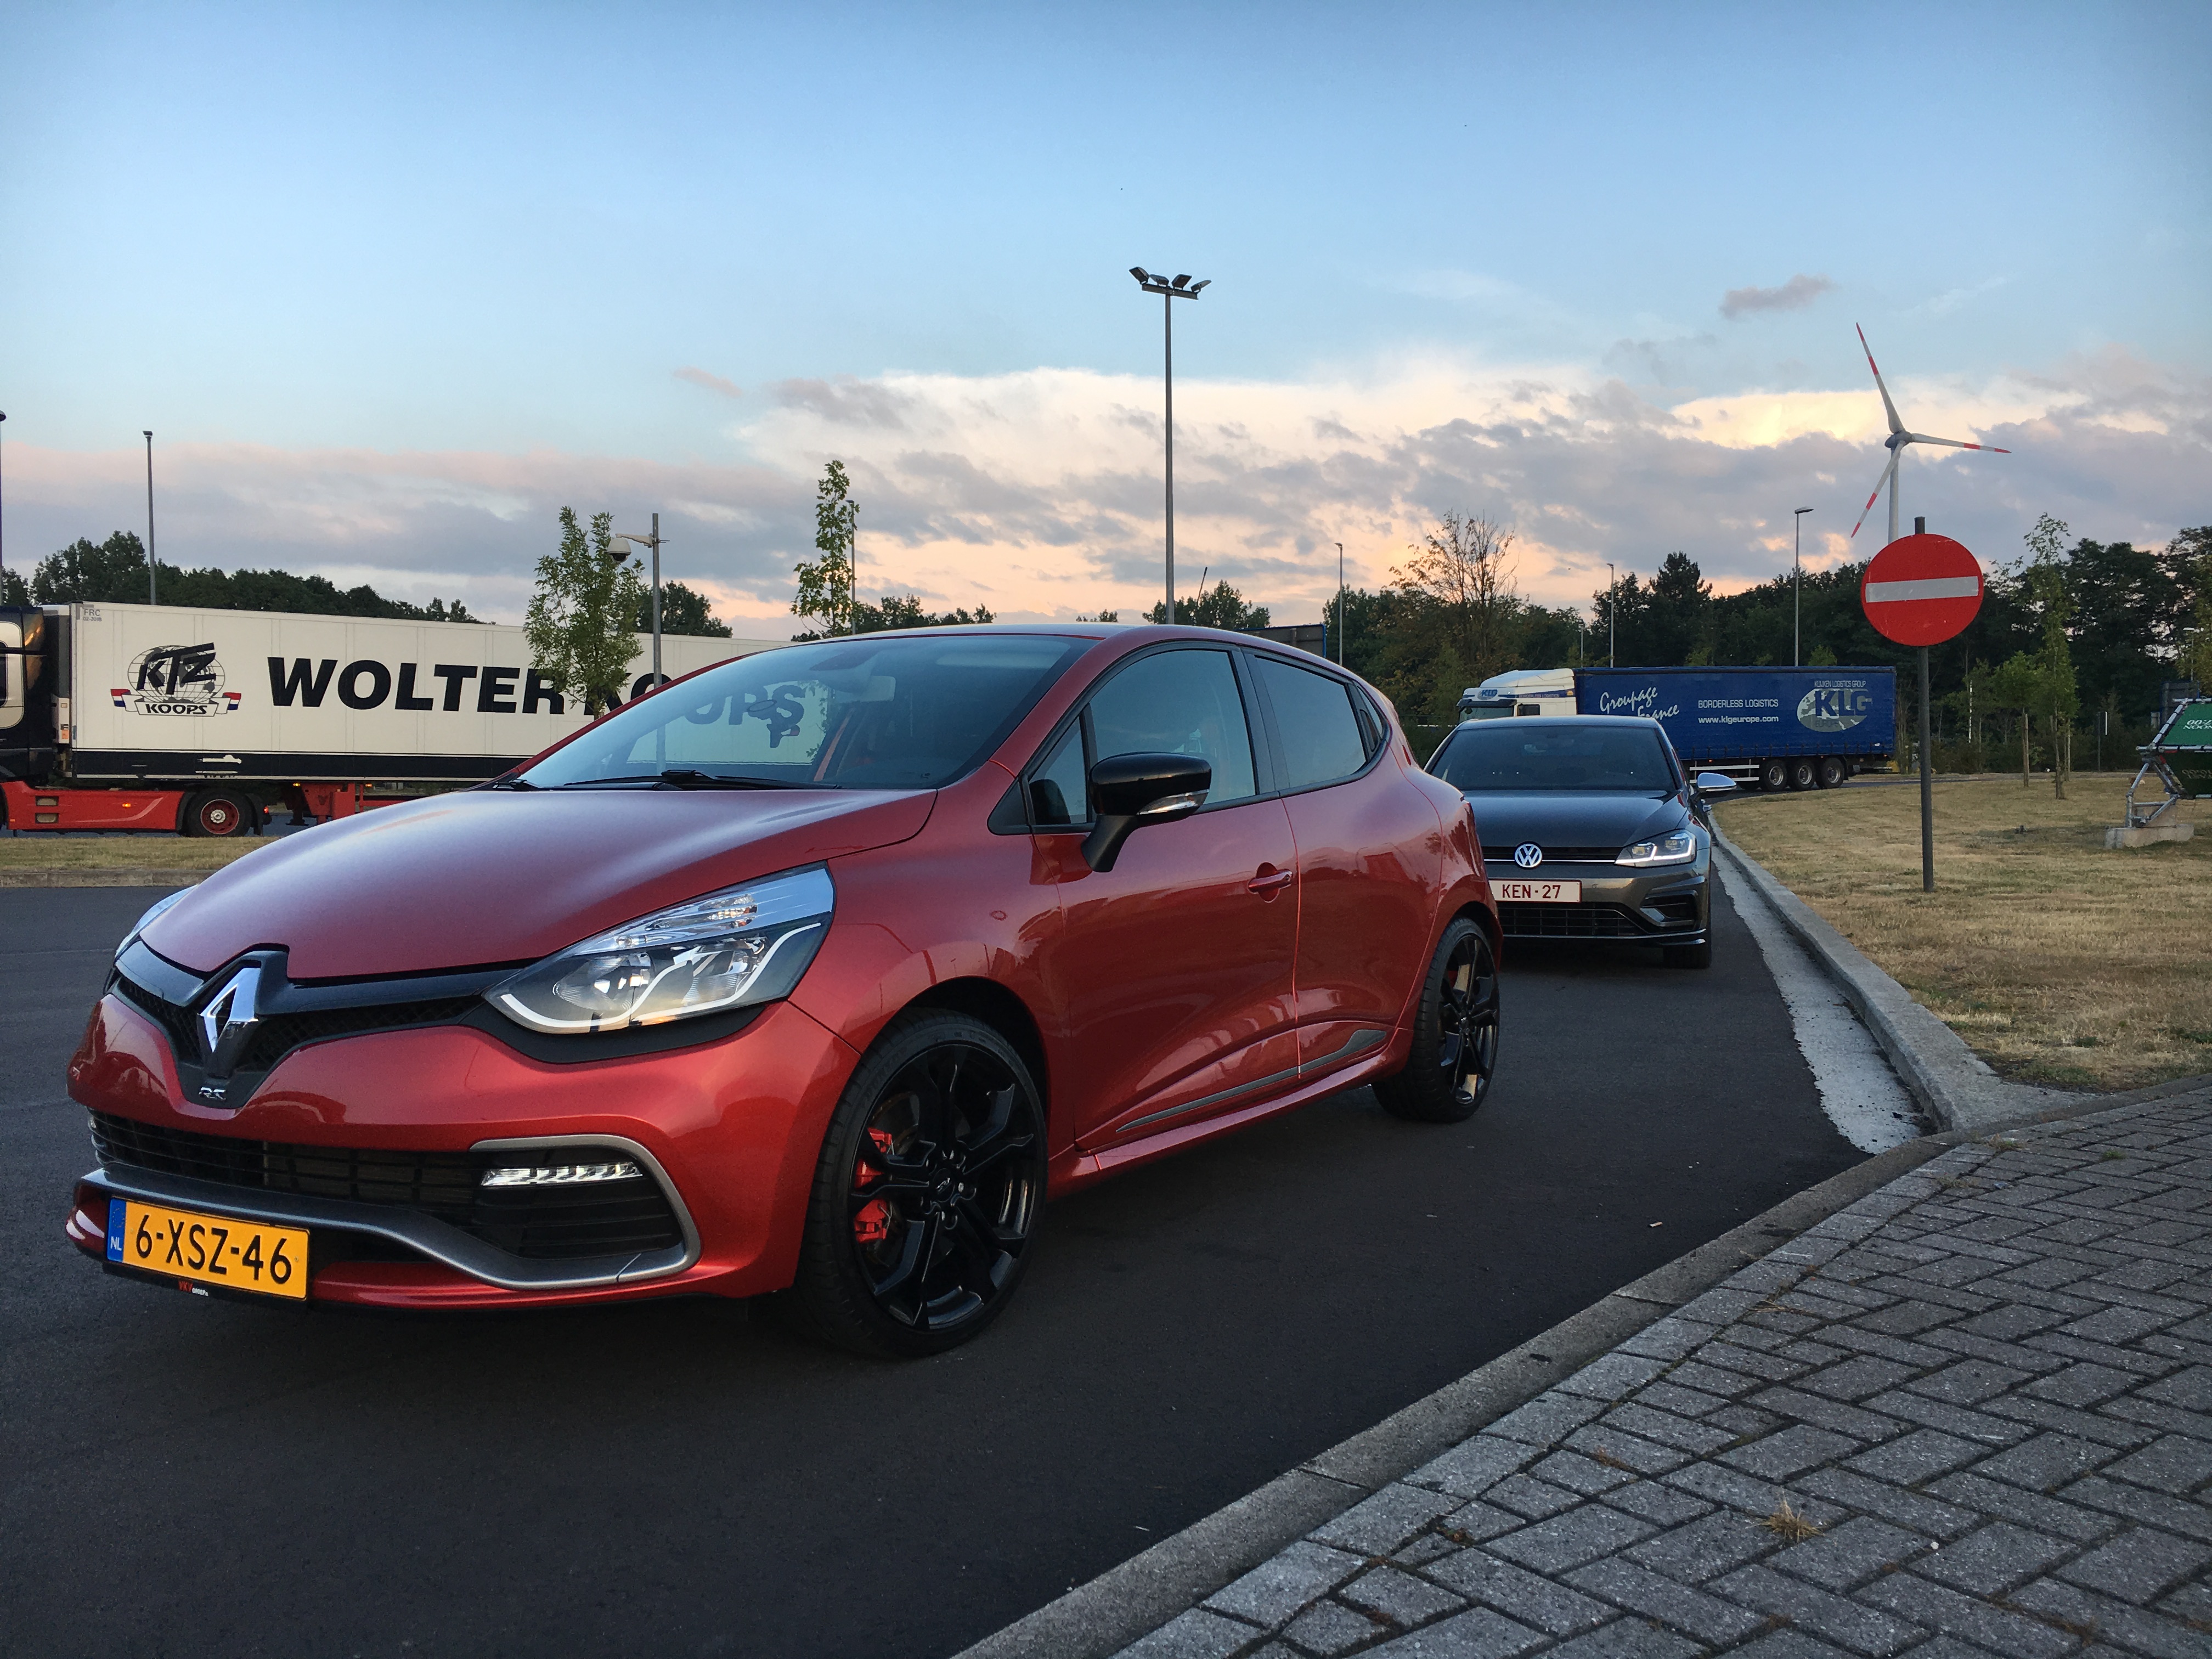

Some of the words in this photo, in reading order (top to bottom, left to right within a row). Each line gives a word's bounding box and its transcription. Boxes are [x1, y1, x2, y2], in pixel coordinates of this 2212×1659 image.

[84, 608, 101, 617] FRC
[267, 657, 565, 715] WOLTER
[1600, 687, 1658, 714] Groupage
[1698, 699, 1743, 708] BORDERLESS
[1745, 699, 1779, 708] LOGISTICS
[1815, 691, 1872, 716] KLG
[145, 703, 207, 715] KOOPS
[1698, 715, 1779, 725] www.klgeurope.com
[1502, 884, 1561, 899] KEN-27
[110, 1235, 122, 1251] NL
[136, 1214, 292, 1284] 6-XSZ-46
